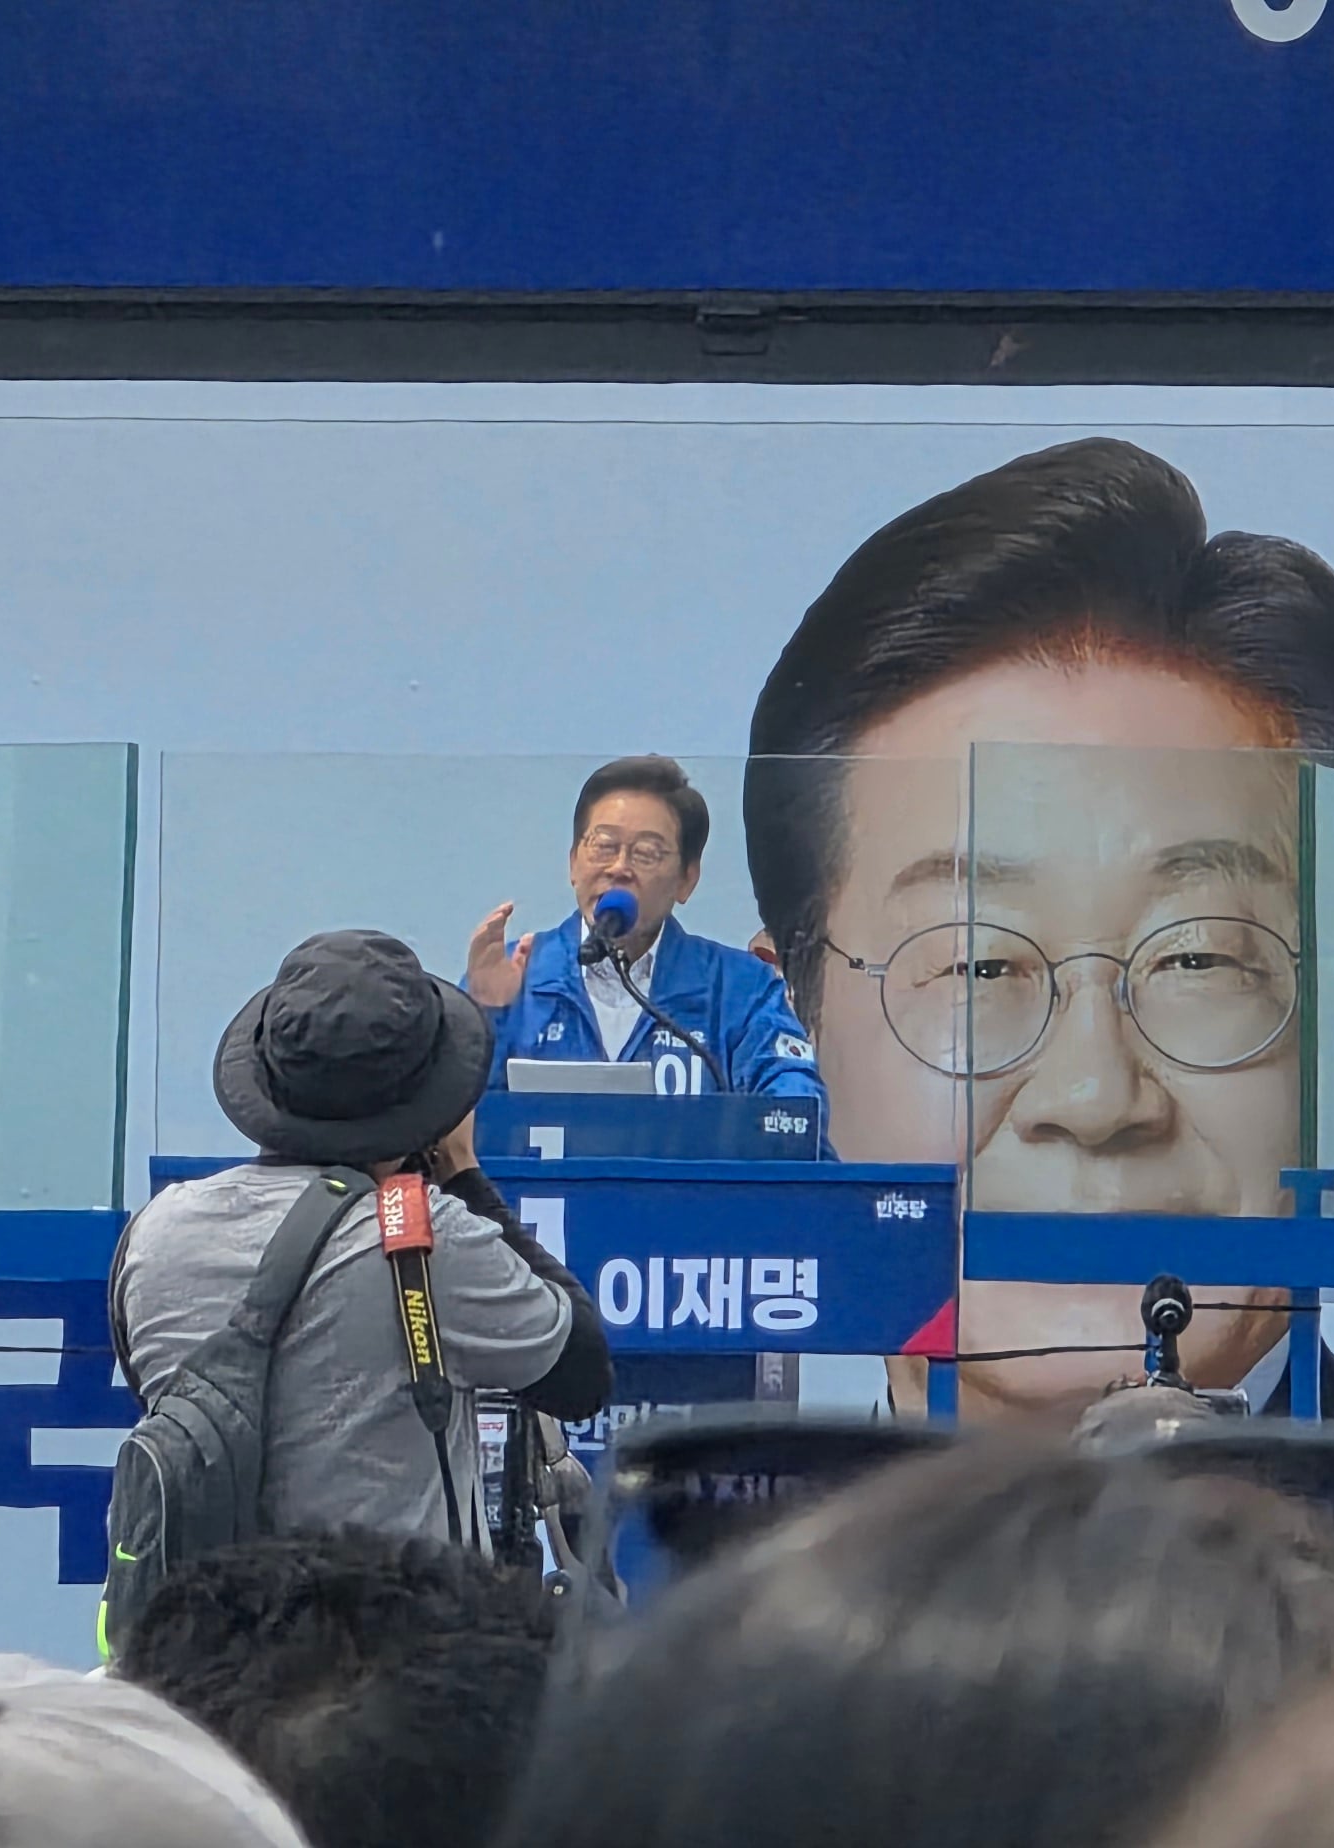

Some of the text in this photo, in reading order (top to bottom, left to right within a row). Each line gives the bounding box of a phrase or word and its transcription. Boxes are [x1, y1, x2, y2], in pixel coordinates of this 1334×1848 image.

[383, 1186, 404, 1238] PRESS
[876, 1199, 928, 1219] 민주당
[598, 1257, 819, 1330] 이재명
[404, 1289, 432, 1365] Nikon
